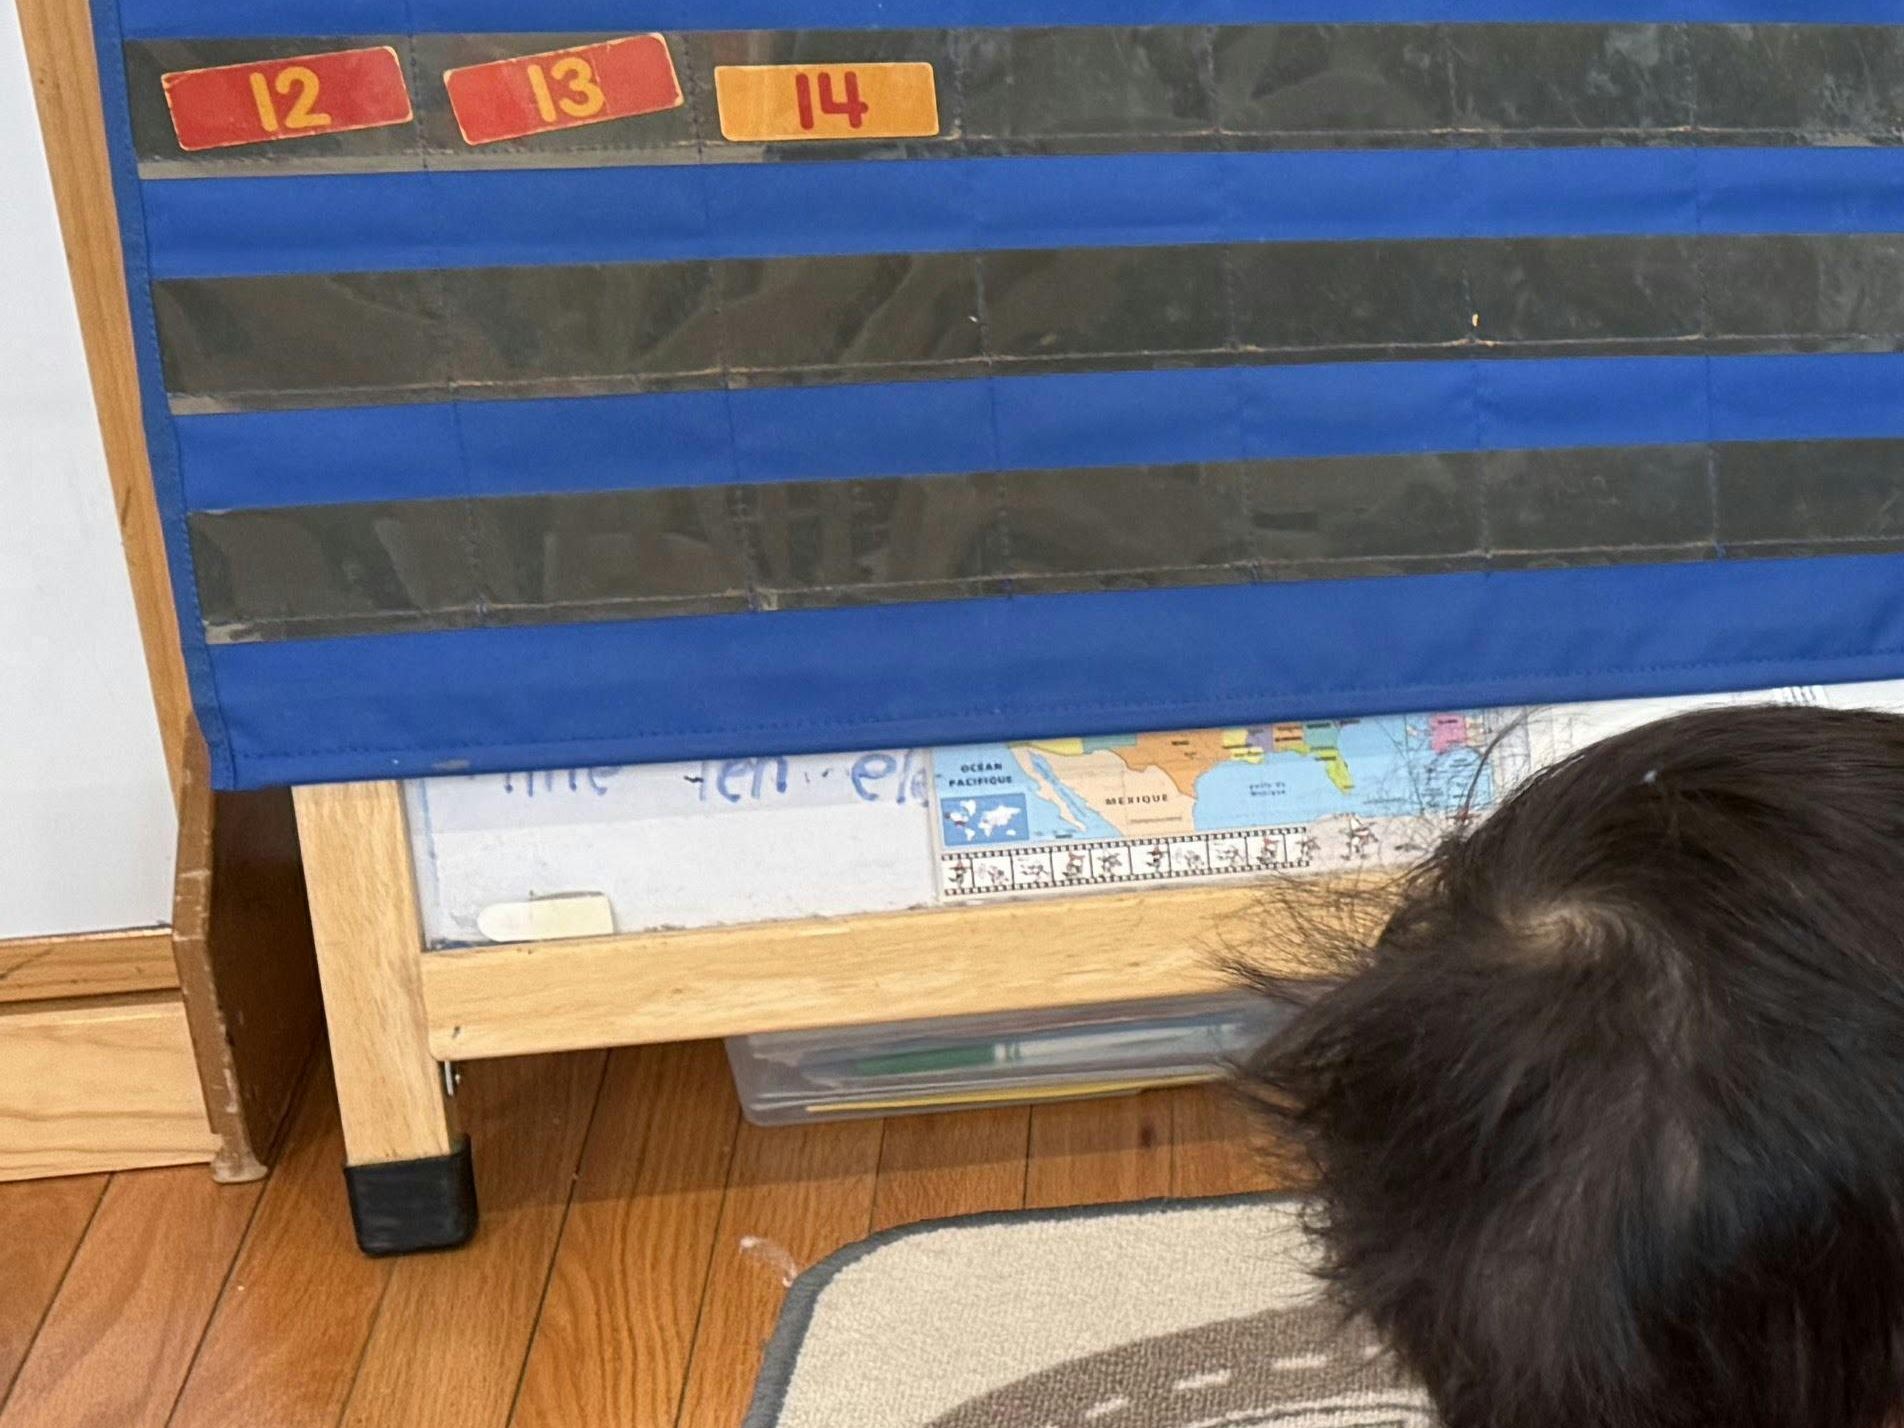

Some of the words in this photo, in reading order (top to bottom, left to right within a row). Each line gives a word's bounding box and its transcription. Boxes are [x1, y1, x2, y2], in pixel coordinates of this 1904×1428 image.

[248, 66, 332, 134] 12
[525, 57, 608, 122] 13
[795, 71, 869, 130] 14
[949, 775, 1013, 787] PACIFIQUE
[1105, 794, 1169, 806] MEXIQUE
